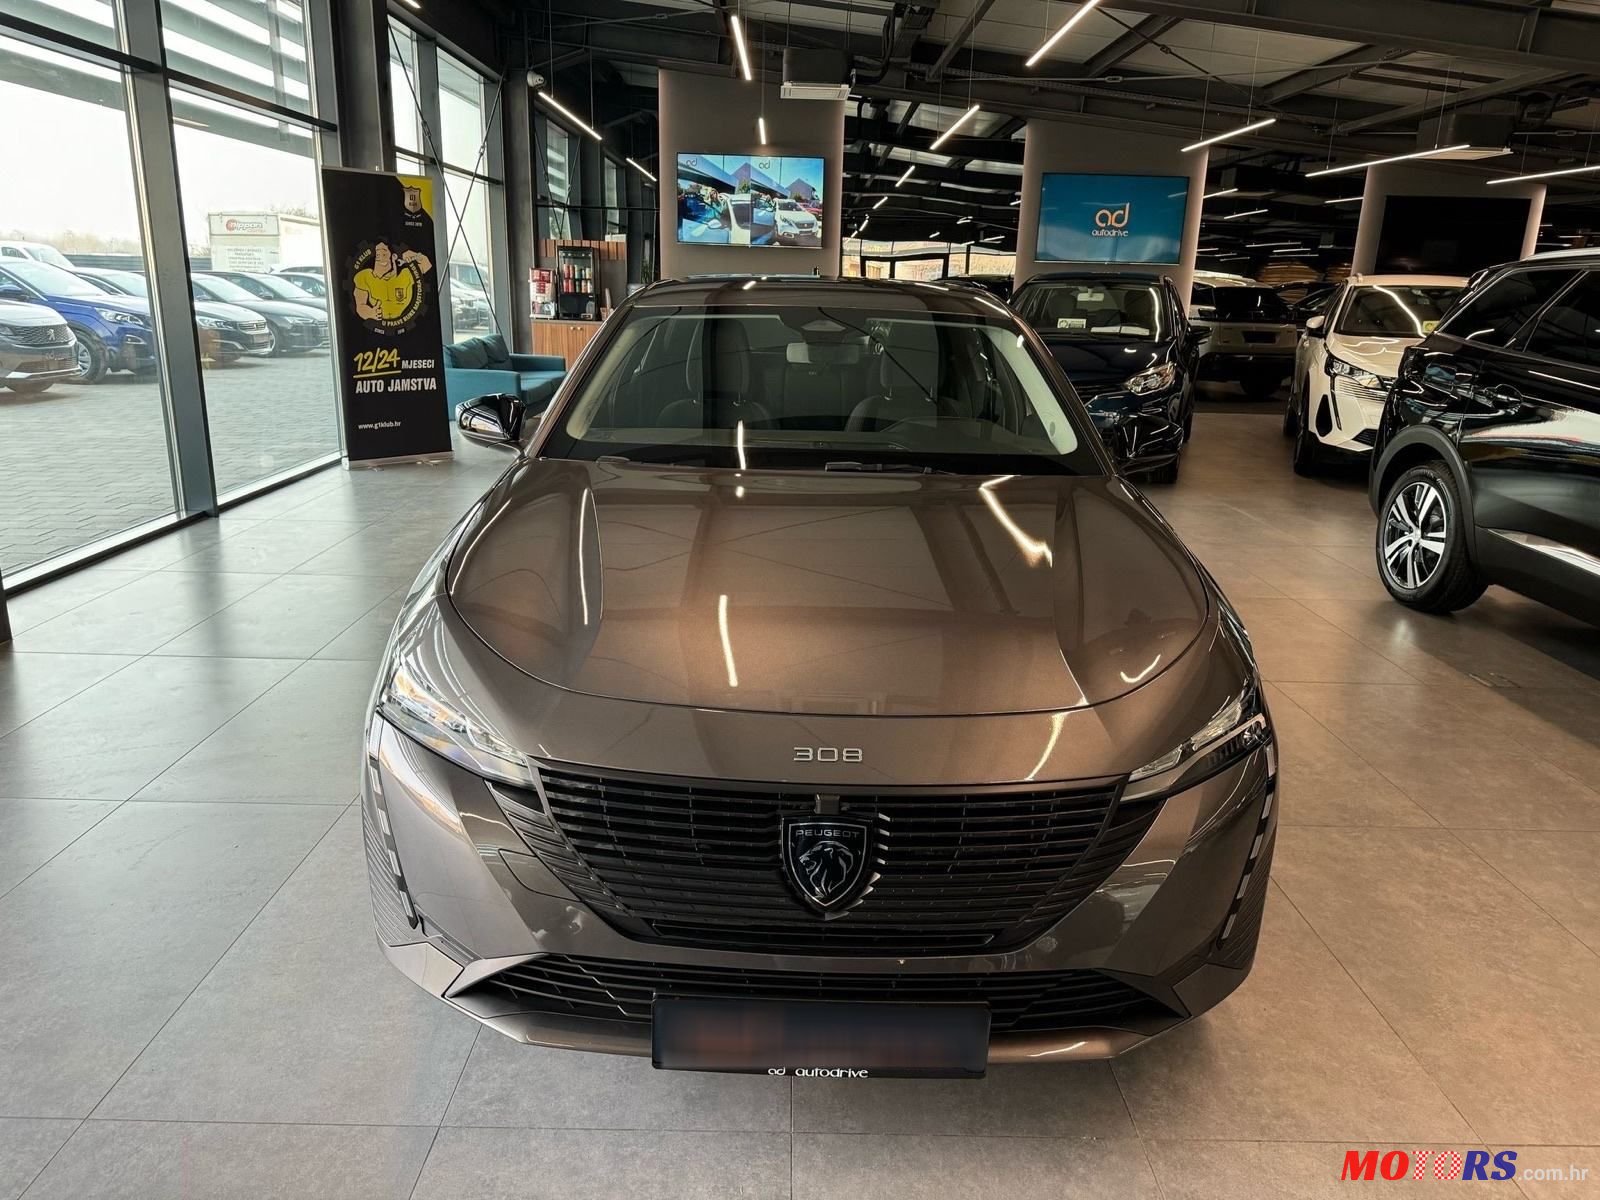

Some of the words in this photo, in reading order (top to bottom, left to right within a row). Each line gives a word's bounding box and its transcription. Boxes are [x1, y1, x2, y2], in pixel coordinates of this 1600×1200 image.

[1095, 202, 1130, 228] ad
[1091, 229, 1129, 237] autodrive
[359, 249, 371, 262] KLUB
[387, 319, 404, 327] PRAVE
[413, 280, 422, 310] MAJSTORA
[353, 347, 401, 373] 12/24
[401, 359, 435, 369] MJESECI
[355, 379, 384, 394] AUTO
[387, 377, 437, 392] JAMSTVA
[358, 420, 402, 430] www.g1klub.hr
[793, 746, 863, 762] 308
[795, 829, 860, 838] PEUGEOT
[767, 1066, 786, 1076] ad
[795, 1067, 869, 1078] autodrive
